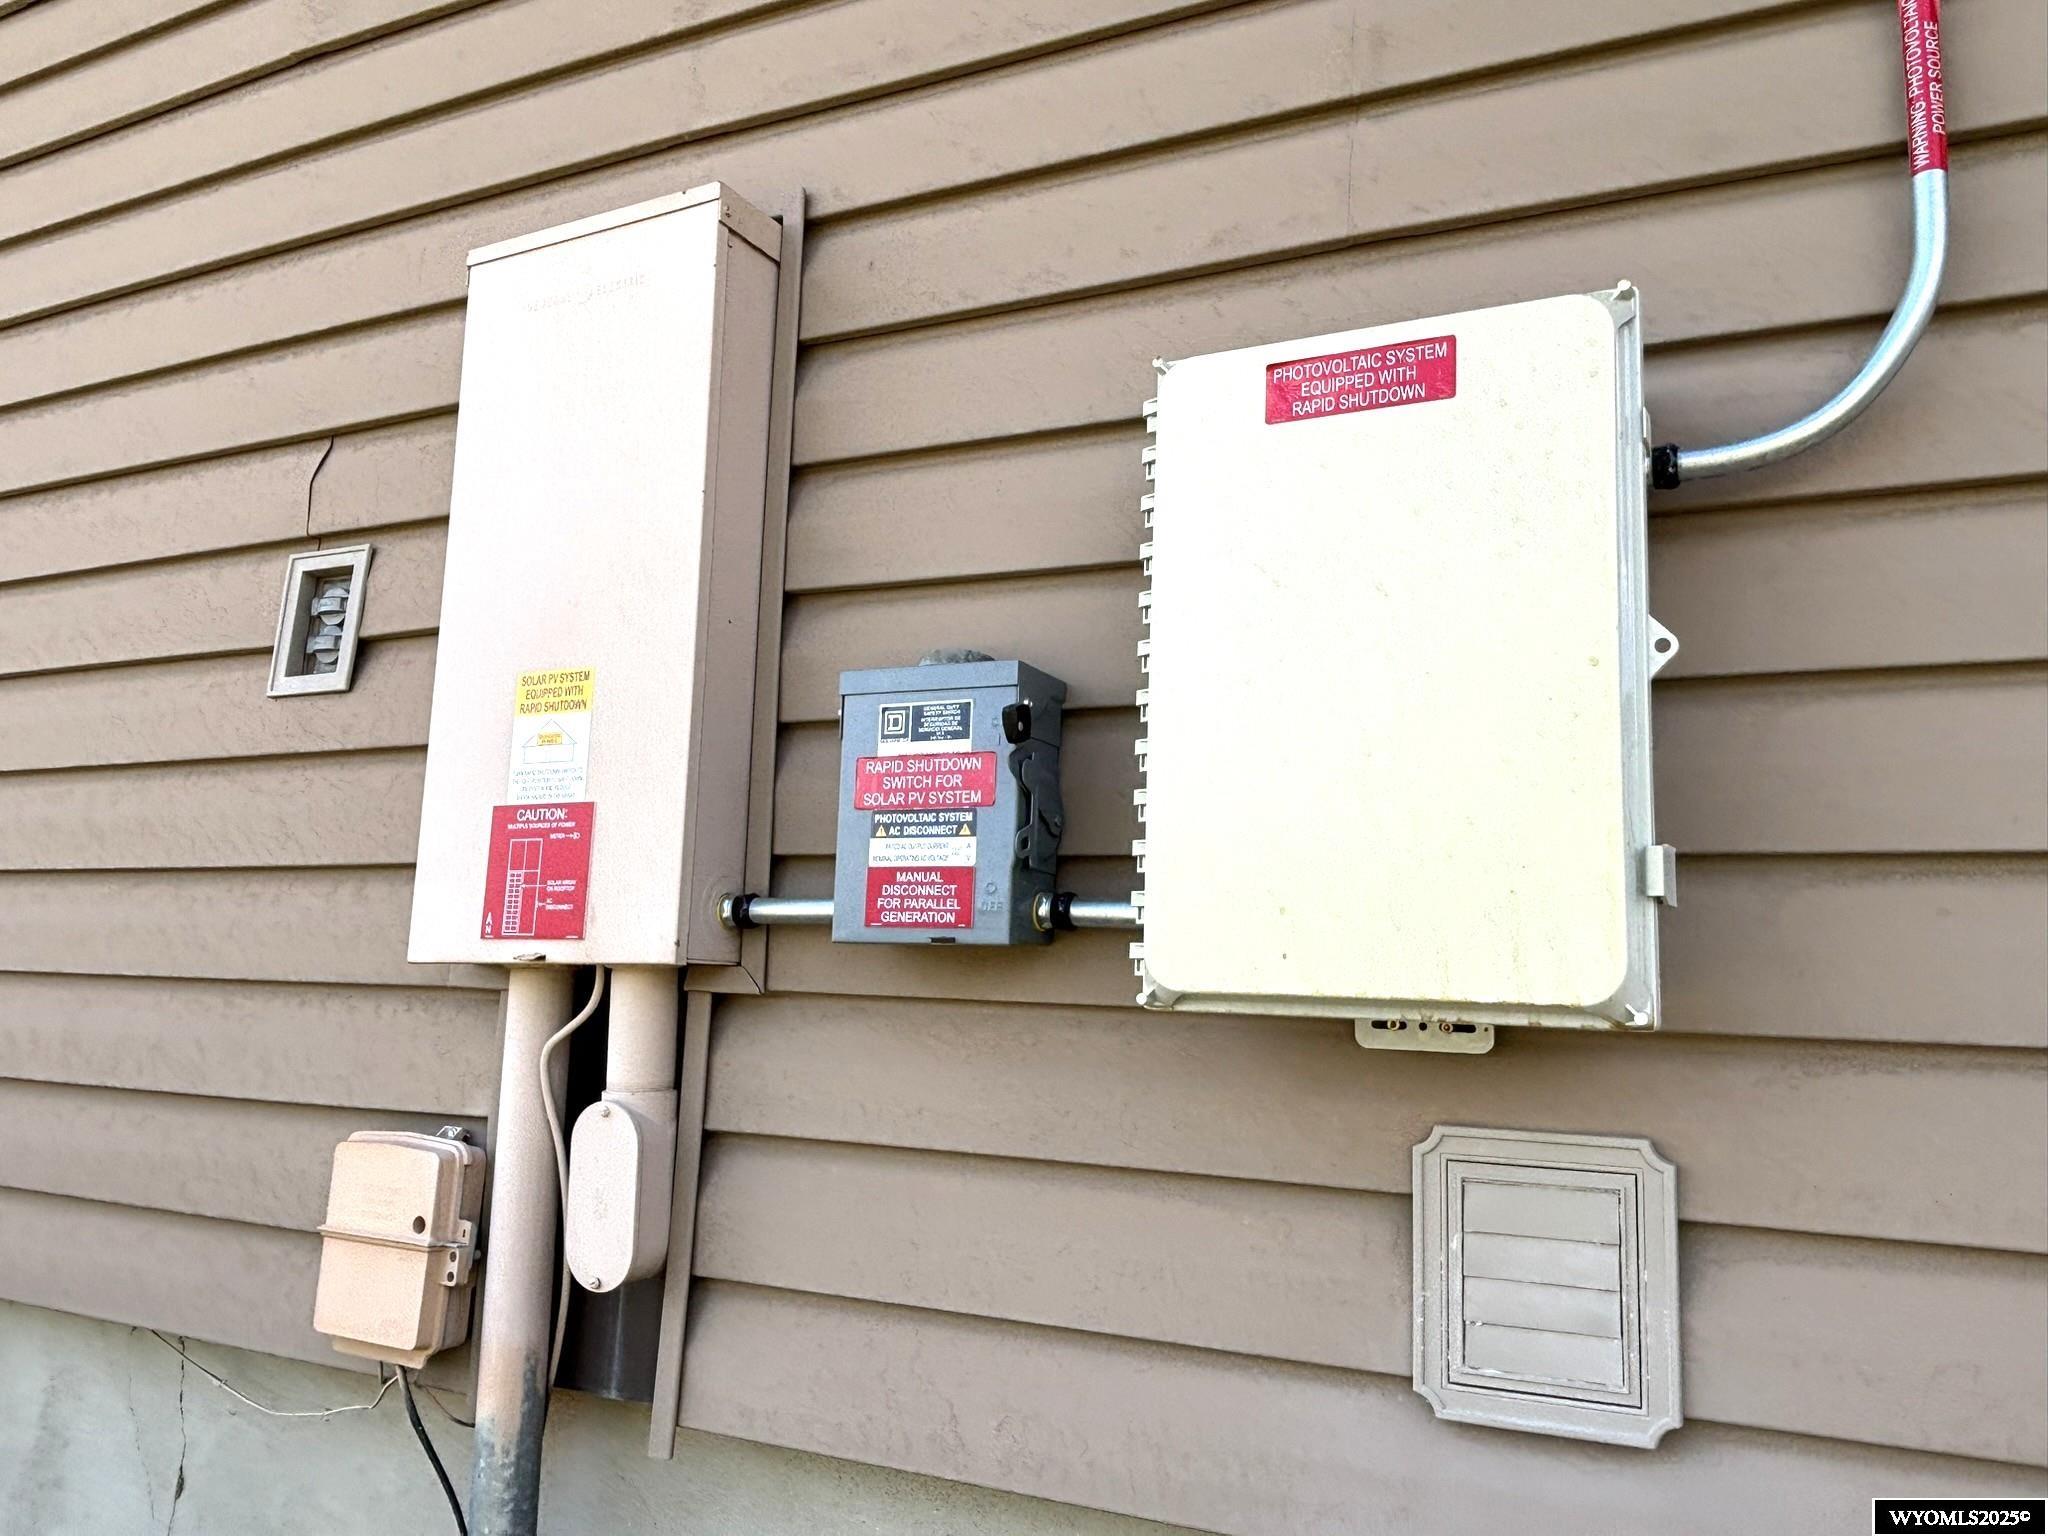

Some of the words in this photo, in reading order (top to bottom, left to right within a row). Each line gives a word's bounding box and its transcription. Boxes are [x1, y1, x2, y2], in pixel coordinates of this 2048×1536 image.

[1924, 21, 1941, 78] SOURCE
[1929, 81, 1946, 135] POWER
[1273, 353, 1382, 384] PHOTOVOLTAIC
[1386, 342, 1447, 364] SYSTEM
[1301, 372, 1375, 397] EQUIPPED
[1378, 365, 1417, 384] WITH
[1292, 397, 1335, 416] RAPID
[1339, 383, 1425, 409] SHUTDOWN
[522, 674, 546, 687] SOLAR
[549, 674, 558, 684] PV
[560, 670, 590, 684] SYSTEM
[526, 687, 562, 700] EQUIPPED
[565, 685, 584, 696] WITH
[520, 703, 542, 714] RAPID
[544, 699, 587, 712] SHUTDOWN
[865, 760, 903, 774] RAPID
[907, 757, 981, 773] SHUTDOWN
[882, 775, 931, 790] SWITCH
[935, 774, 962, 788] FOR
[863, 793, 905, 806] SOLAR
[908, 792, 926, 805] PV
[928, 790, 981, 804] SYSTEM
[874, 813, 936, 824] PHOTOVOLTAIC
[938, 811, 973, 822] SYSTEM
[889, 826, 900, 836] AC
[903, 825, 958, 835] DISCONNECT
[896, 871, 944, 882] MANUAL
[881, 885, 958, 896] DISCONNECT
[877, 898, 901, 909] FOR
[904, 898, 961, 909] PARALLEL
[880, 911, 955, 923] GENERATION
